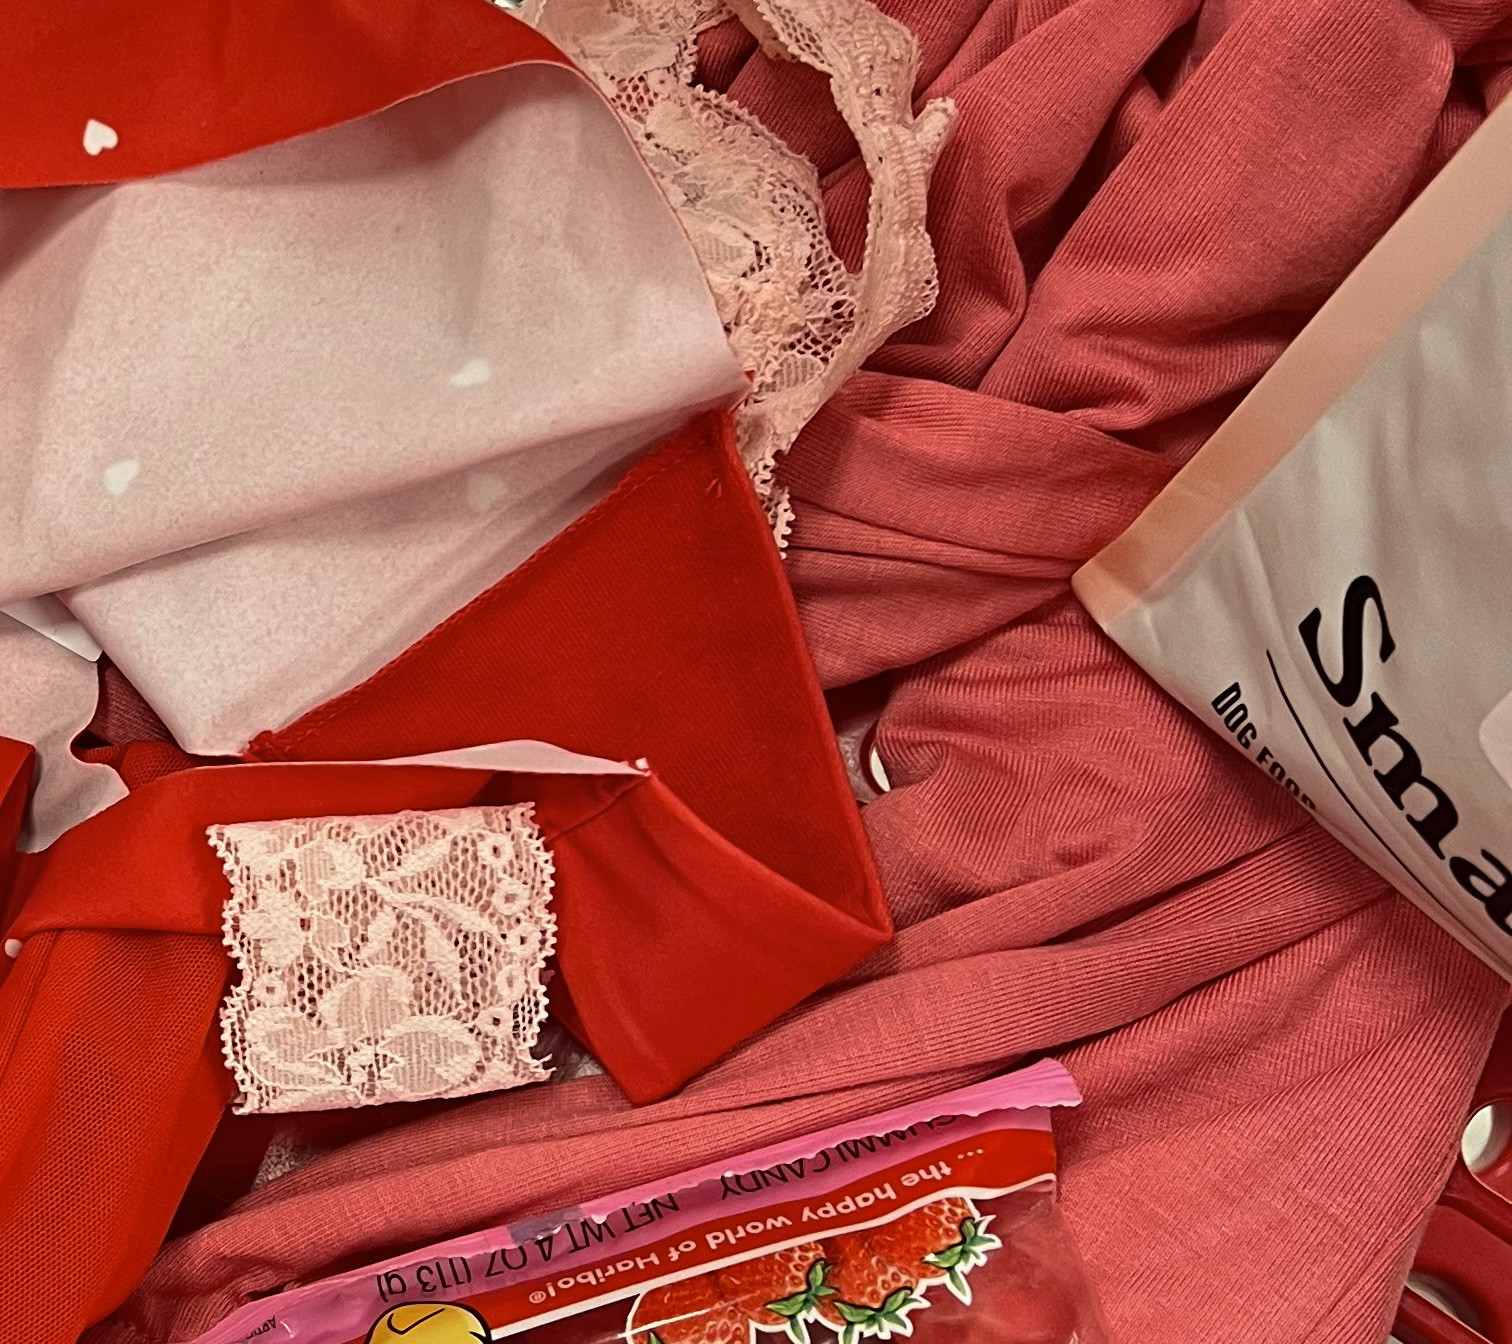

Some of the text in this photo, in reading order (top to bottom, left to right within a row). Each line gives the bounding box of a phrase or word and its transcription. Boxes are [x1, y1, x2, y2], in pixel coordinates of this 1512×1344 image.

[1211, 682, 1257, 750] DOG
[720, 1150, 830, 1200] CANDY
[900, 1161, 952, 1187] the
[801, 1182, 897, 1222] happy
[565, 1219, 615, 1253] WT
[705, 1215, 792, 1249] world
[534, 1237, 554, 1262] 4
[667, 1239, 697, 1262] of
